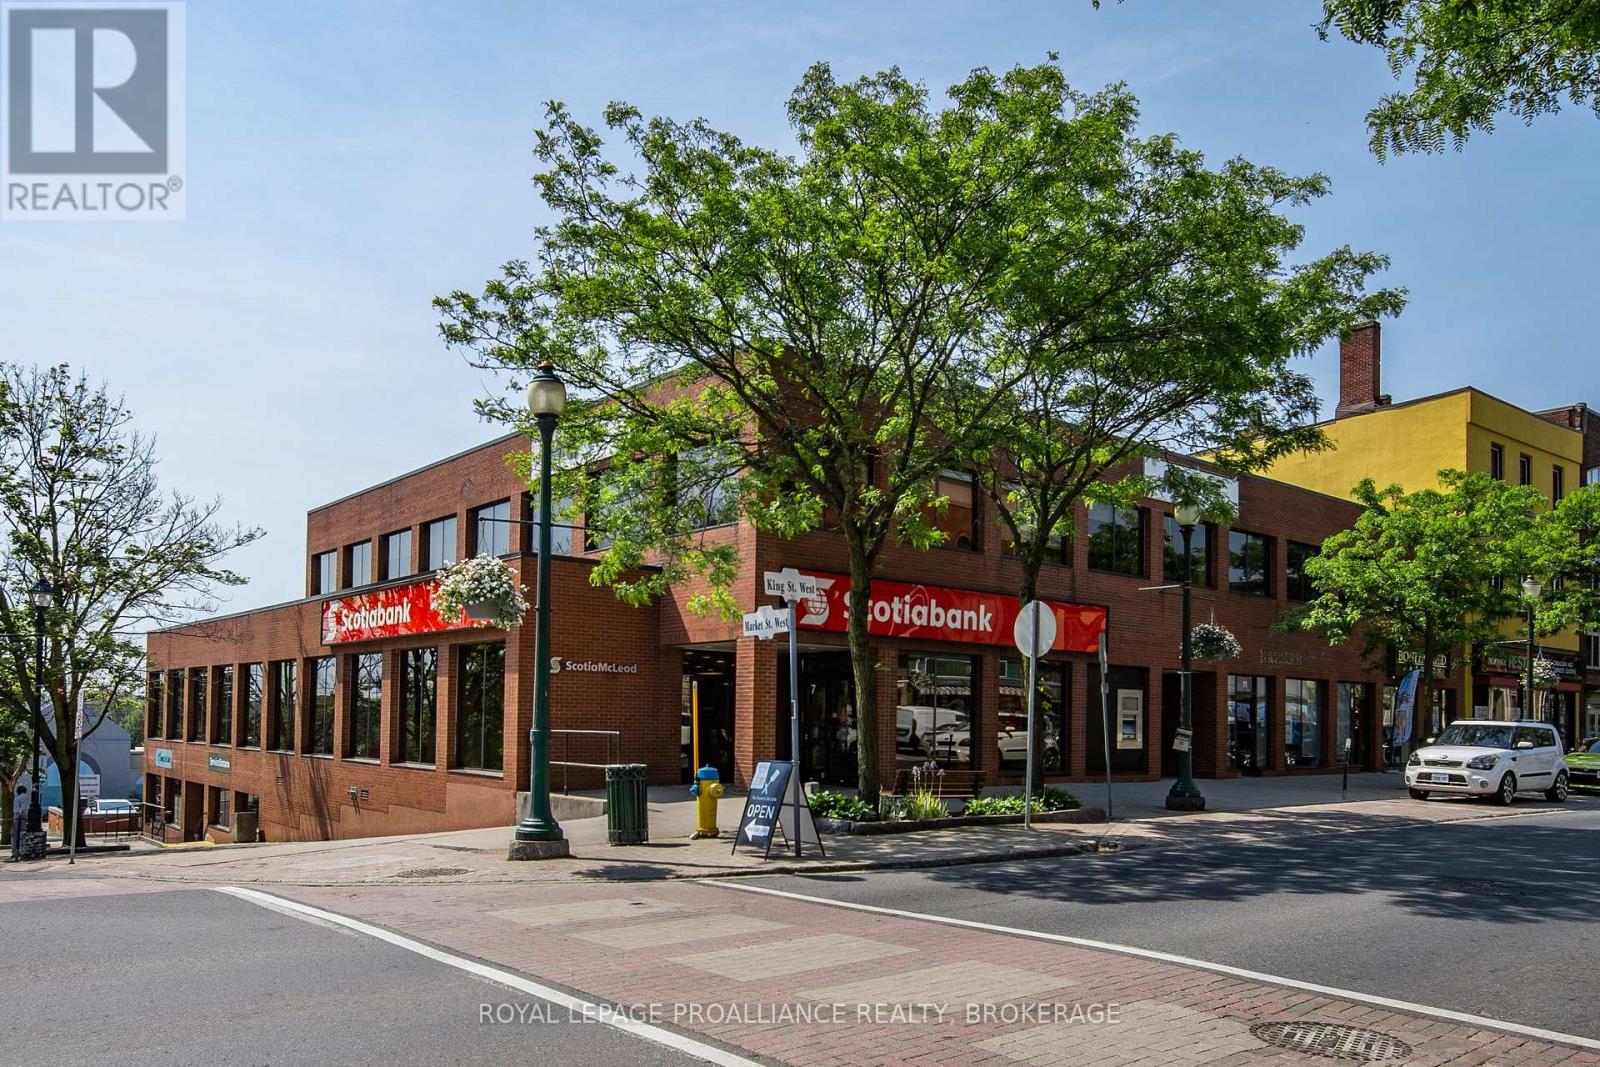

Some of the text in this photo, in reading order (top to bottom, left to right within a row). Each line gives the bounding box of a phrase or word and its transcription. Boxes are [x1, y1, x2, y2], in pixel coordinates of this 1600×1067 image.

[767, 579, 815, 594] King St. West
[341, 597, 411, 631] Scotiabank
[745, 617, 789, 632] Market St. West
[565, 661, 637, 673] ScotiaMcLeod
[810, 684, 816, 694] 7
[747, 804, 775, 819] OPEN
